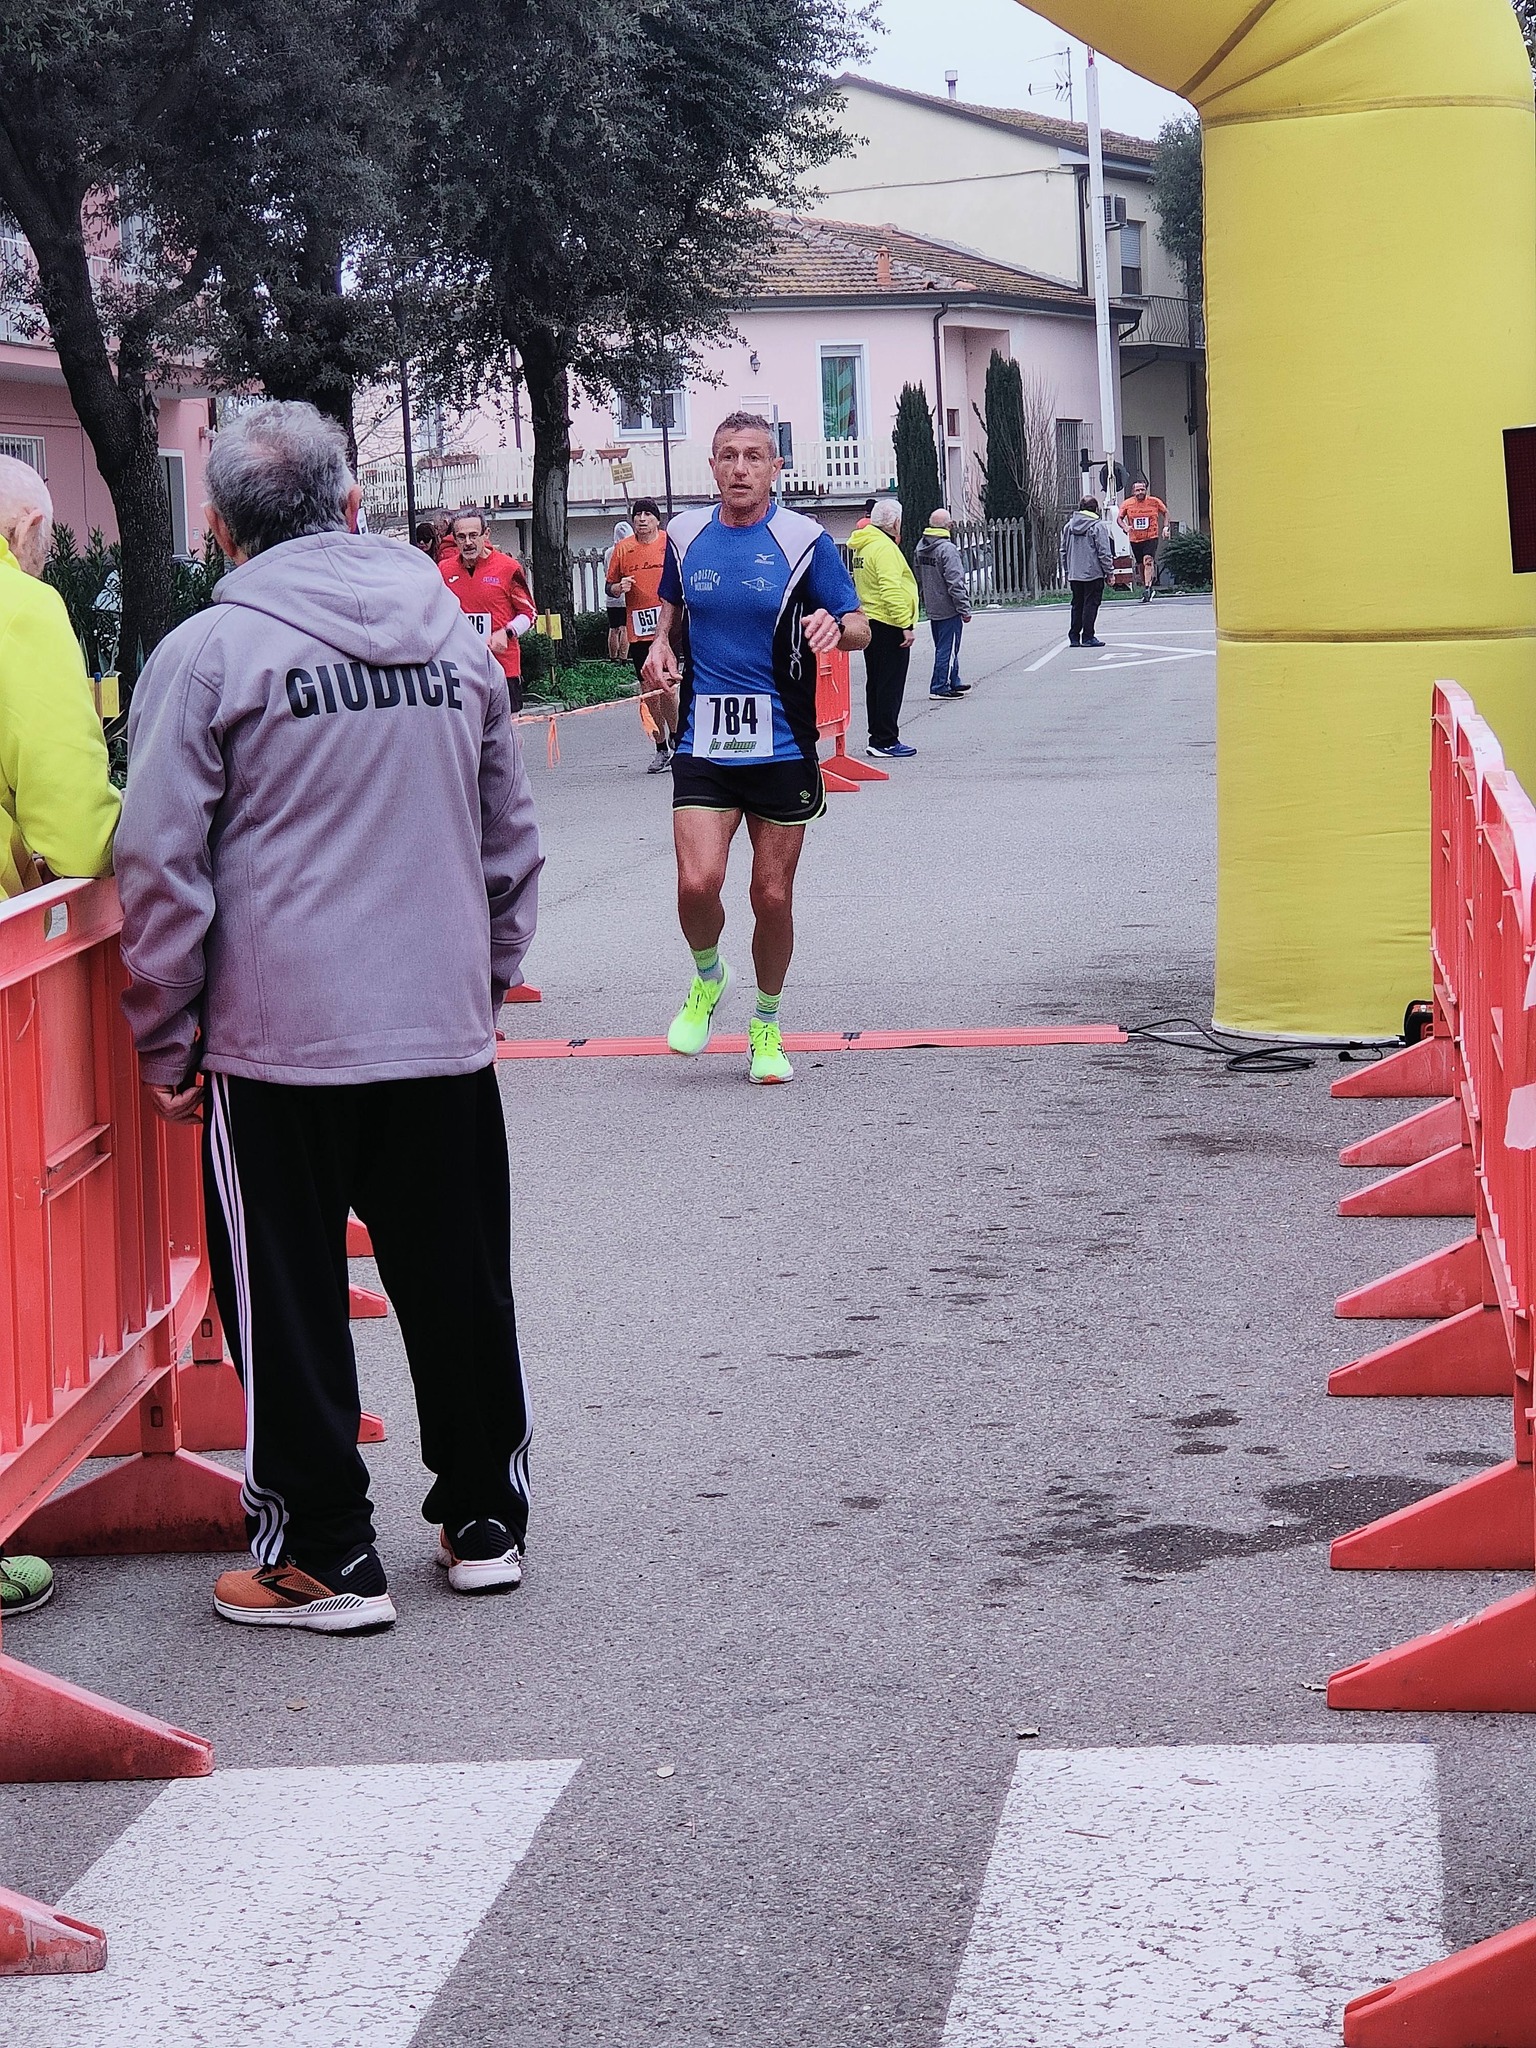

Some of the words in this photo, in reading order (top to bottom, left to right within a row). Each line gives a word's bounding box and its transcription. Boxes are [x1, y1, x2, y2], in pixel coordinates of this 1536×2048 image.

[690, 569, 721, 586] PODISTICA
[637, 608, 658, 627] 657
[285, 659, 463, 719] GIUDICE
[708, 697, 758, 736] 784
